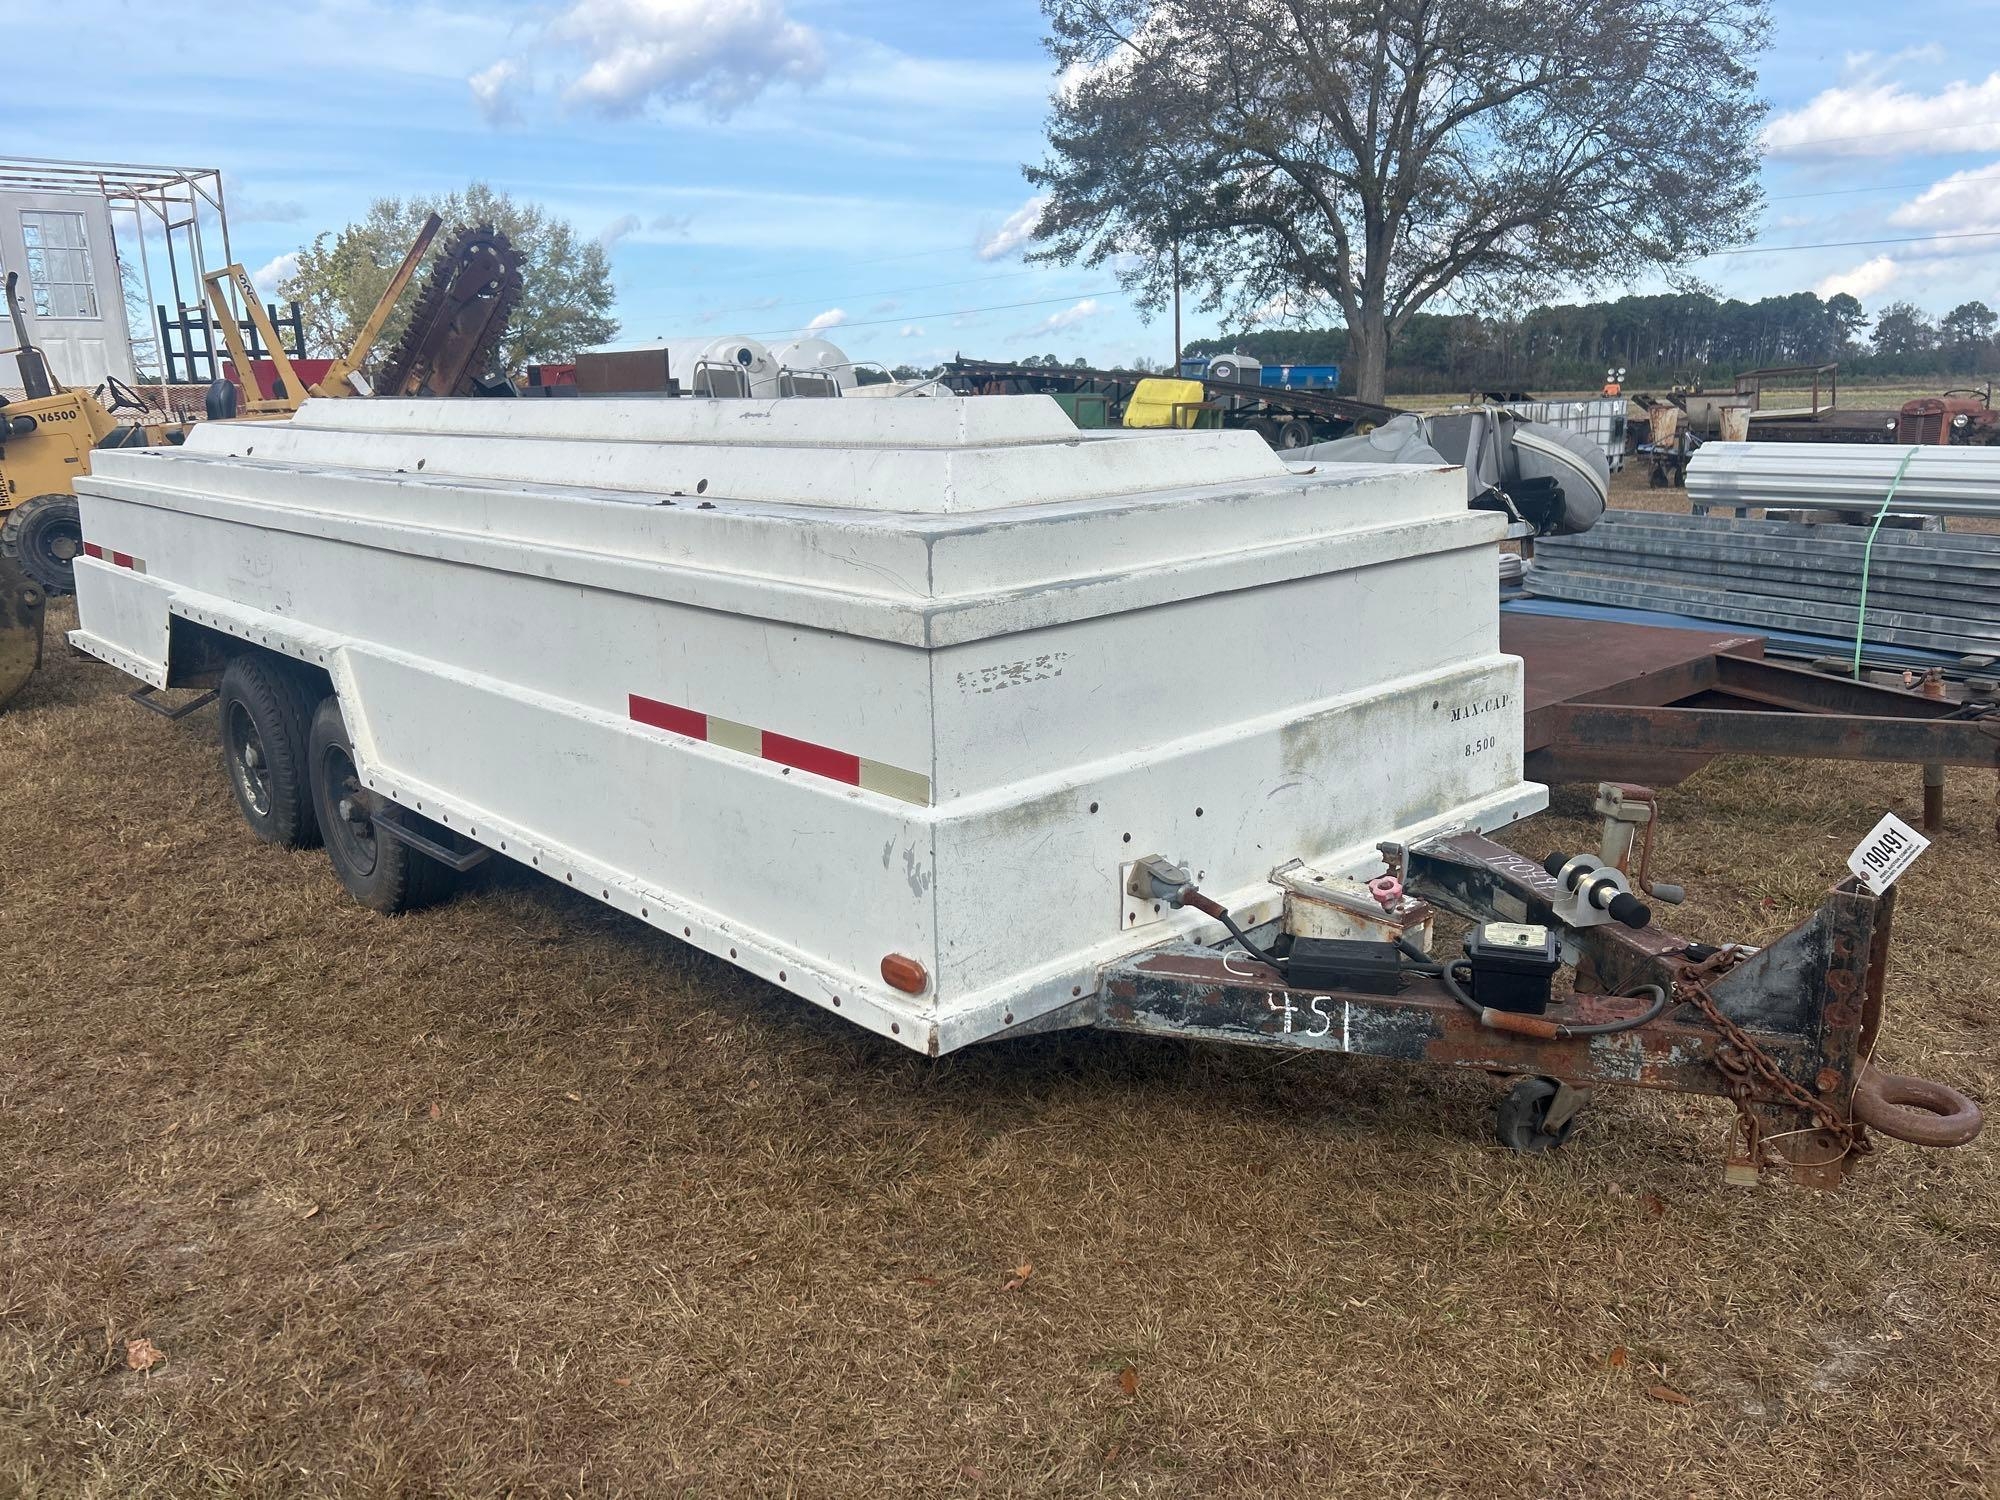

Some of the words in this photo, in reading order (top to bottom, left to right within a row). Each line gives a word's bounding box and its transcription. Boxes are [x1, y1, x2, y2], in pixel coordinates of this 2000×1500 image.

[37, 410, 77, 423] V6500
[1465, 736, 1496, 757] 8,500
[1861, 827, 1908, 873] 190491
[1267, 991, 1350, 1052] 451
